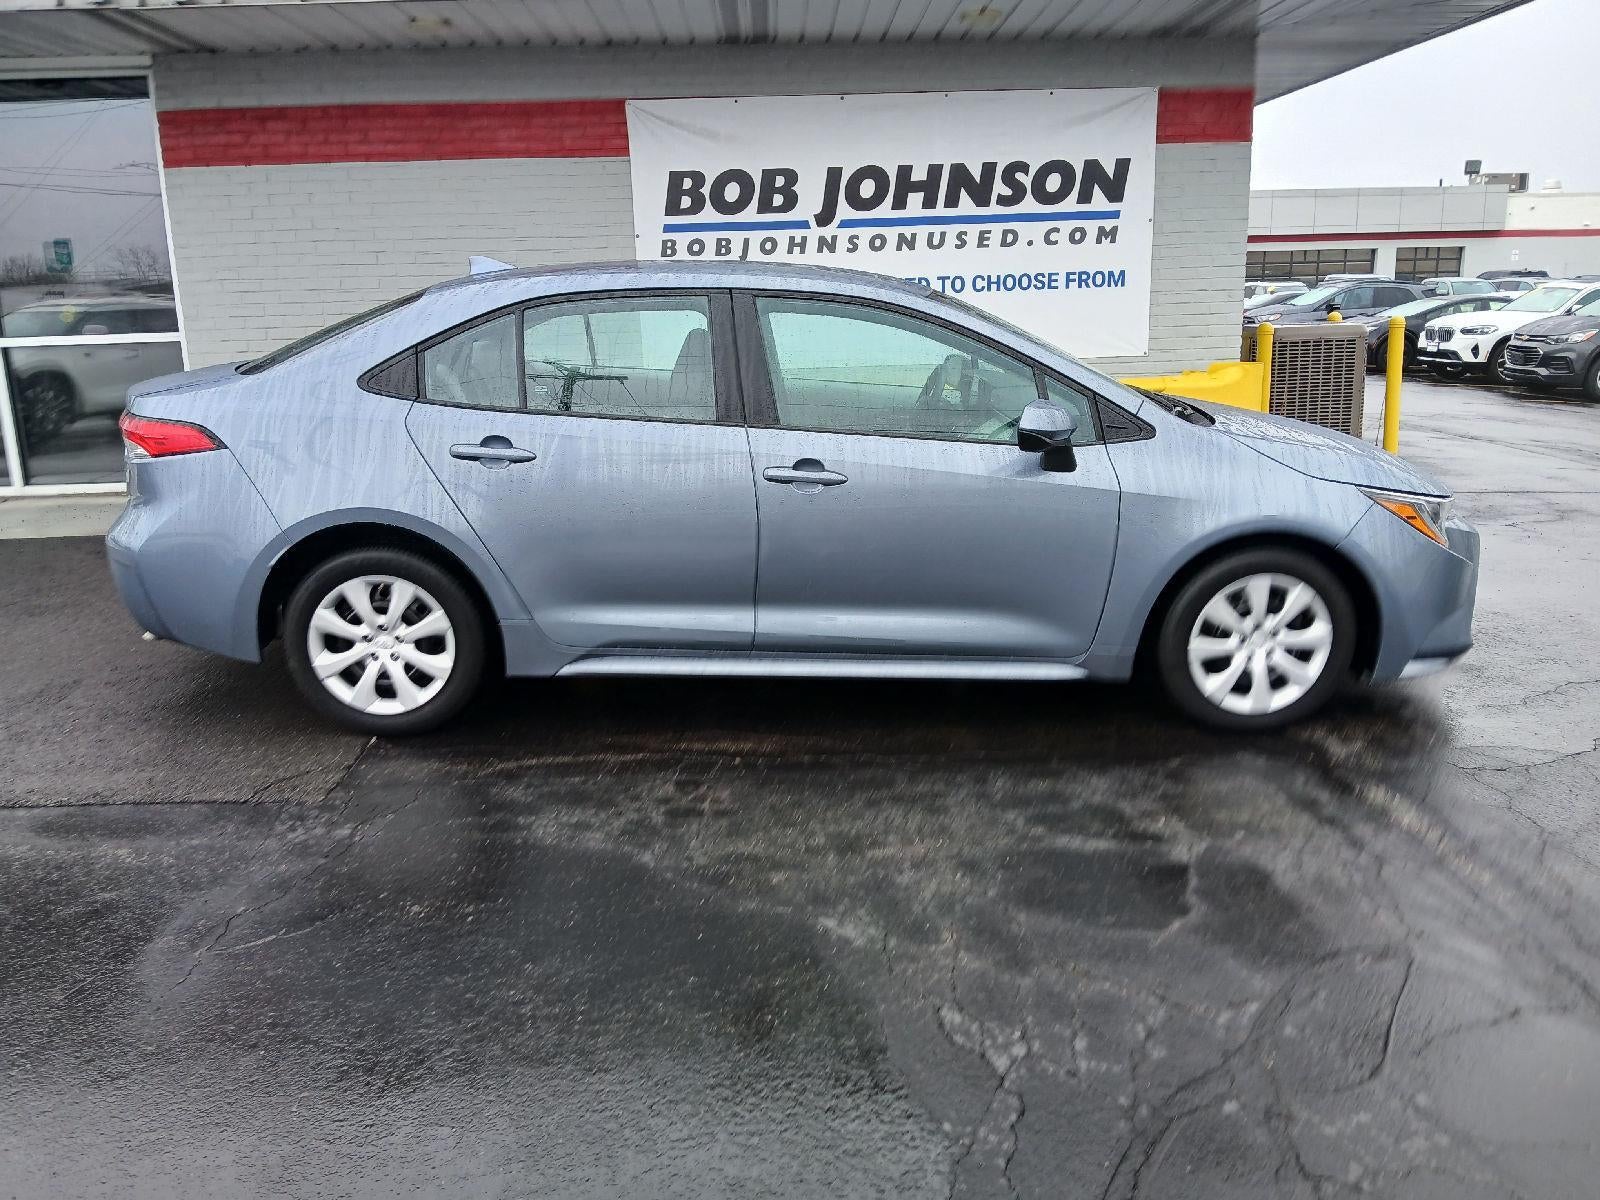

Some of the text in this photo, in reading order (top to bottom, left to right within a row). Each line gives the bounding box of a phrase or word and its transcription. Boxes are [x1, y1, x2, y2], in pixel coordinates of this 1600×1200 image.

[664, 157, 1132, 228] BOB JOHNSON
[660, 225, 1119, 262] BOBJOHNSONUSED.COM
[937, 275, 966, 294] TO
[972, 272, 1060, 293] CHOOSE
[1065, 270, 1126, 289] FROM
